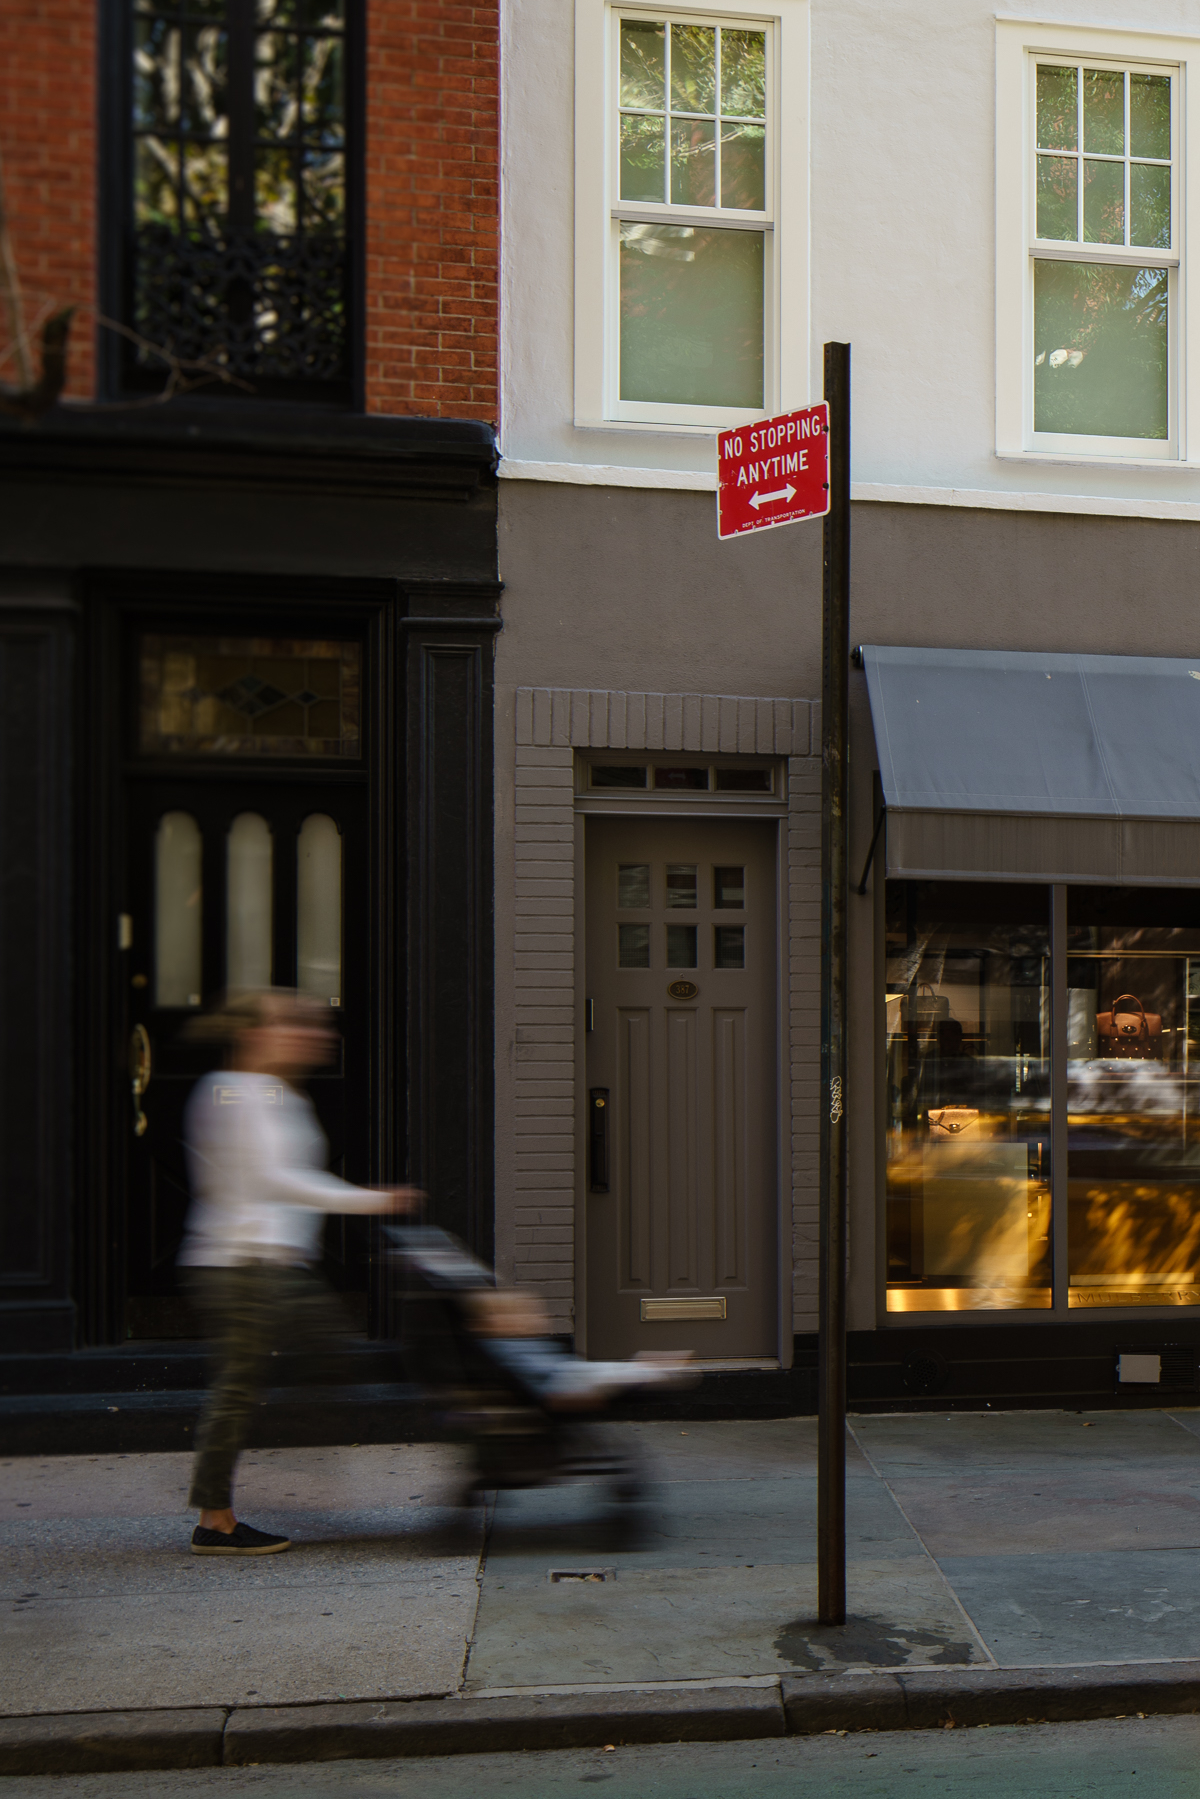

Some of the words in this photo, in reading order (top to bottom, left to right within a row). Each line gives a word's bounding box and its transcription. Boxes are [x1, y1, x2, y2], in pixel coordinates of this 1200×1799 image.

[725, 437, 742, 459] NO
[750, 416, 820, 452] STOPPING
[737, 450, 808, 486] ANYTIME
[765, 509, 805, 522] TRANSPORTATION
[675, 984, 690, 994] 387
